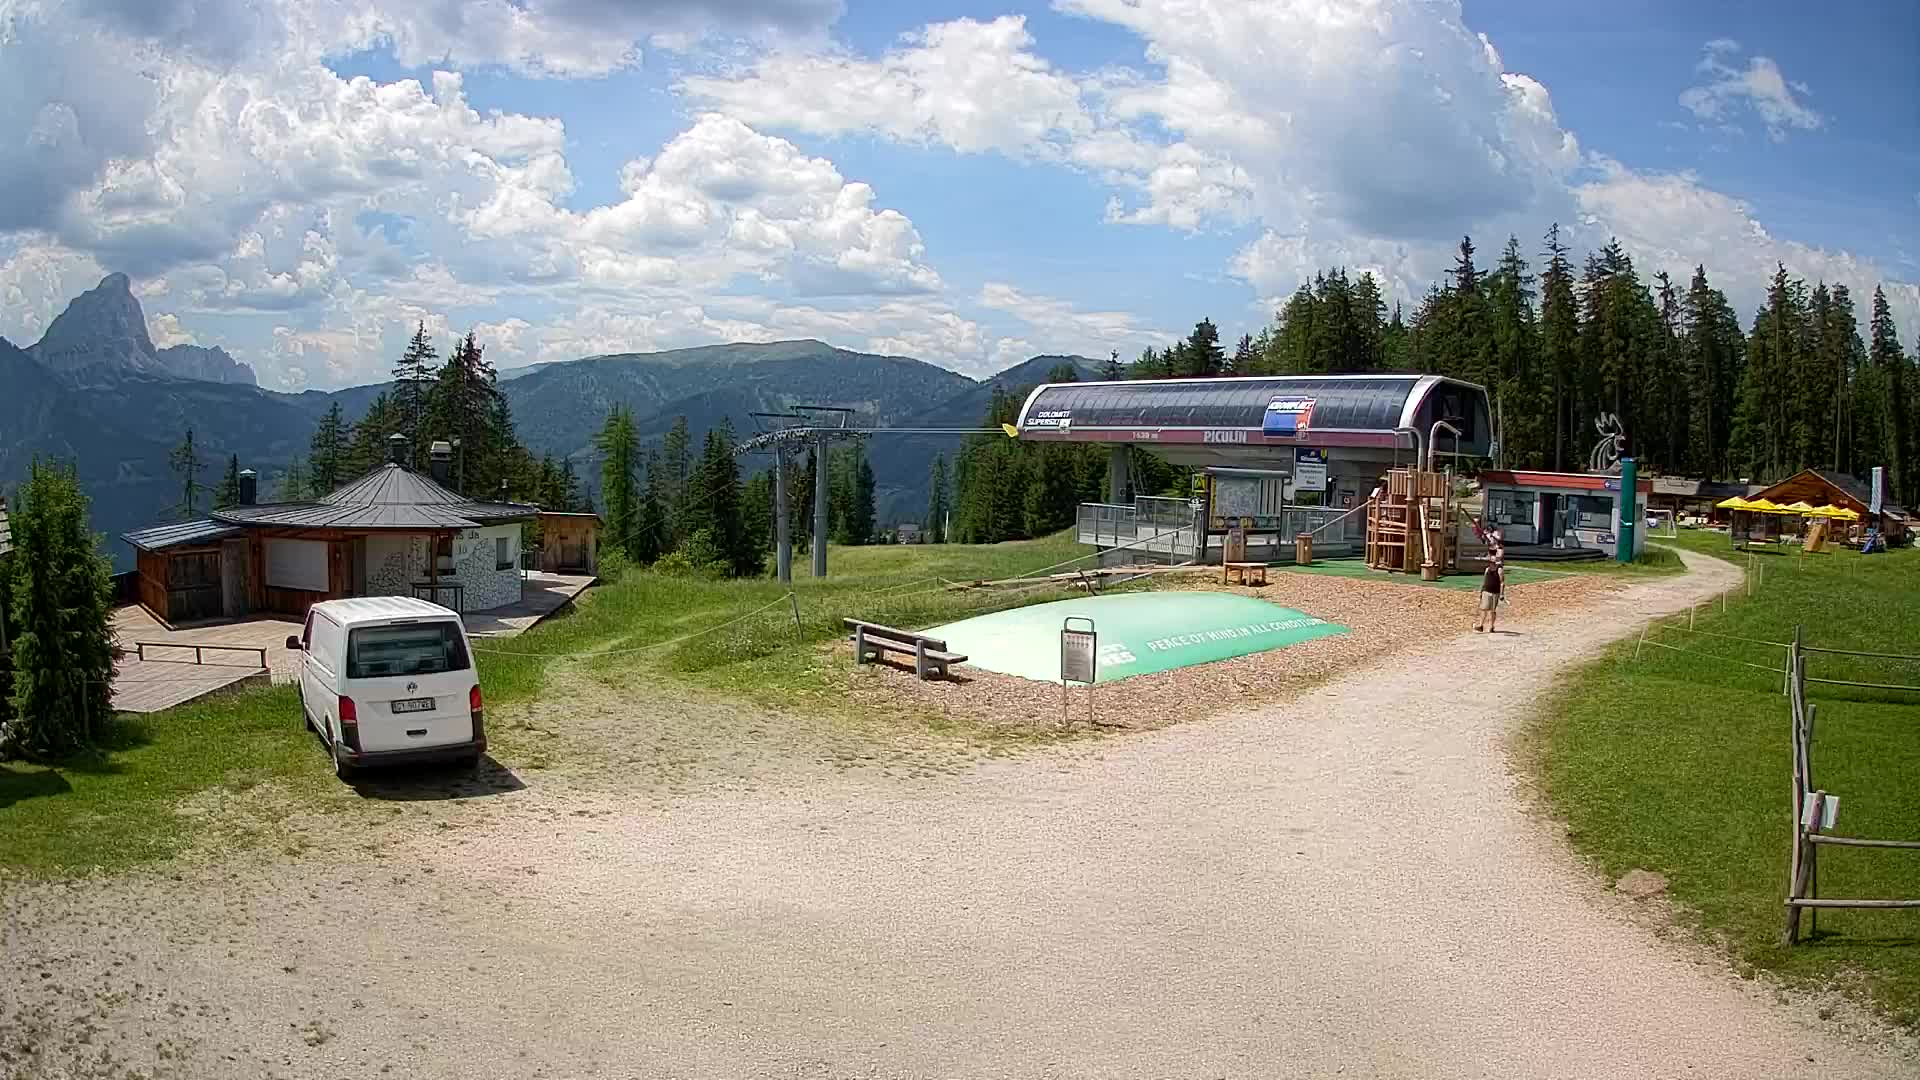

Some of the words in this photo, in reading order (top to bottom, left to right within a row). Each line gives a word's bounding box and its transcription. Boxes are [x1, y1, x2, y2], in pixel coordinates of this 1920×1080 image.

[1203, 431, 1247, 443] PICULIN
[1147, 636, 1191, 652] PEACE
[1206, 629, 1237, 641] MIND
[1250, 623, 1272, 635] ALL
